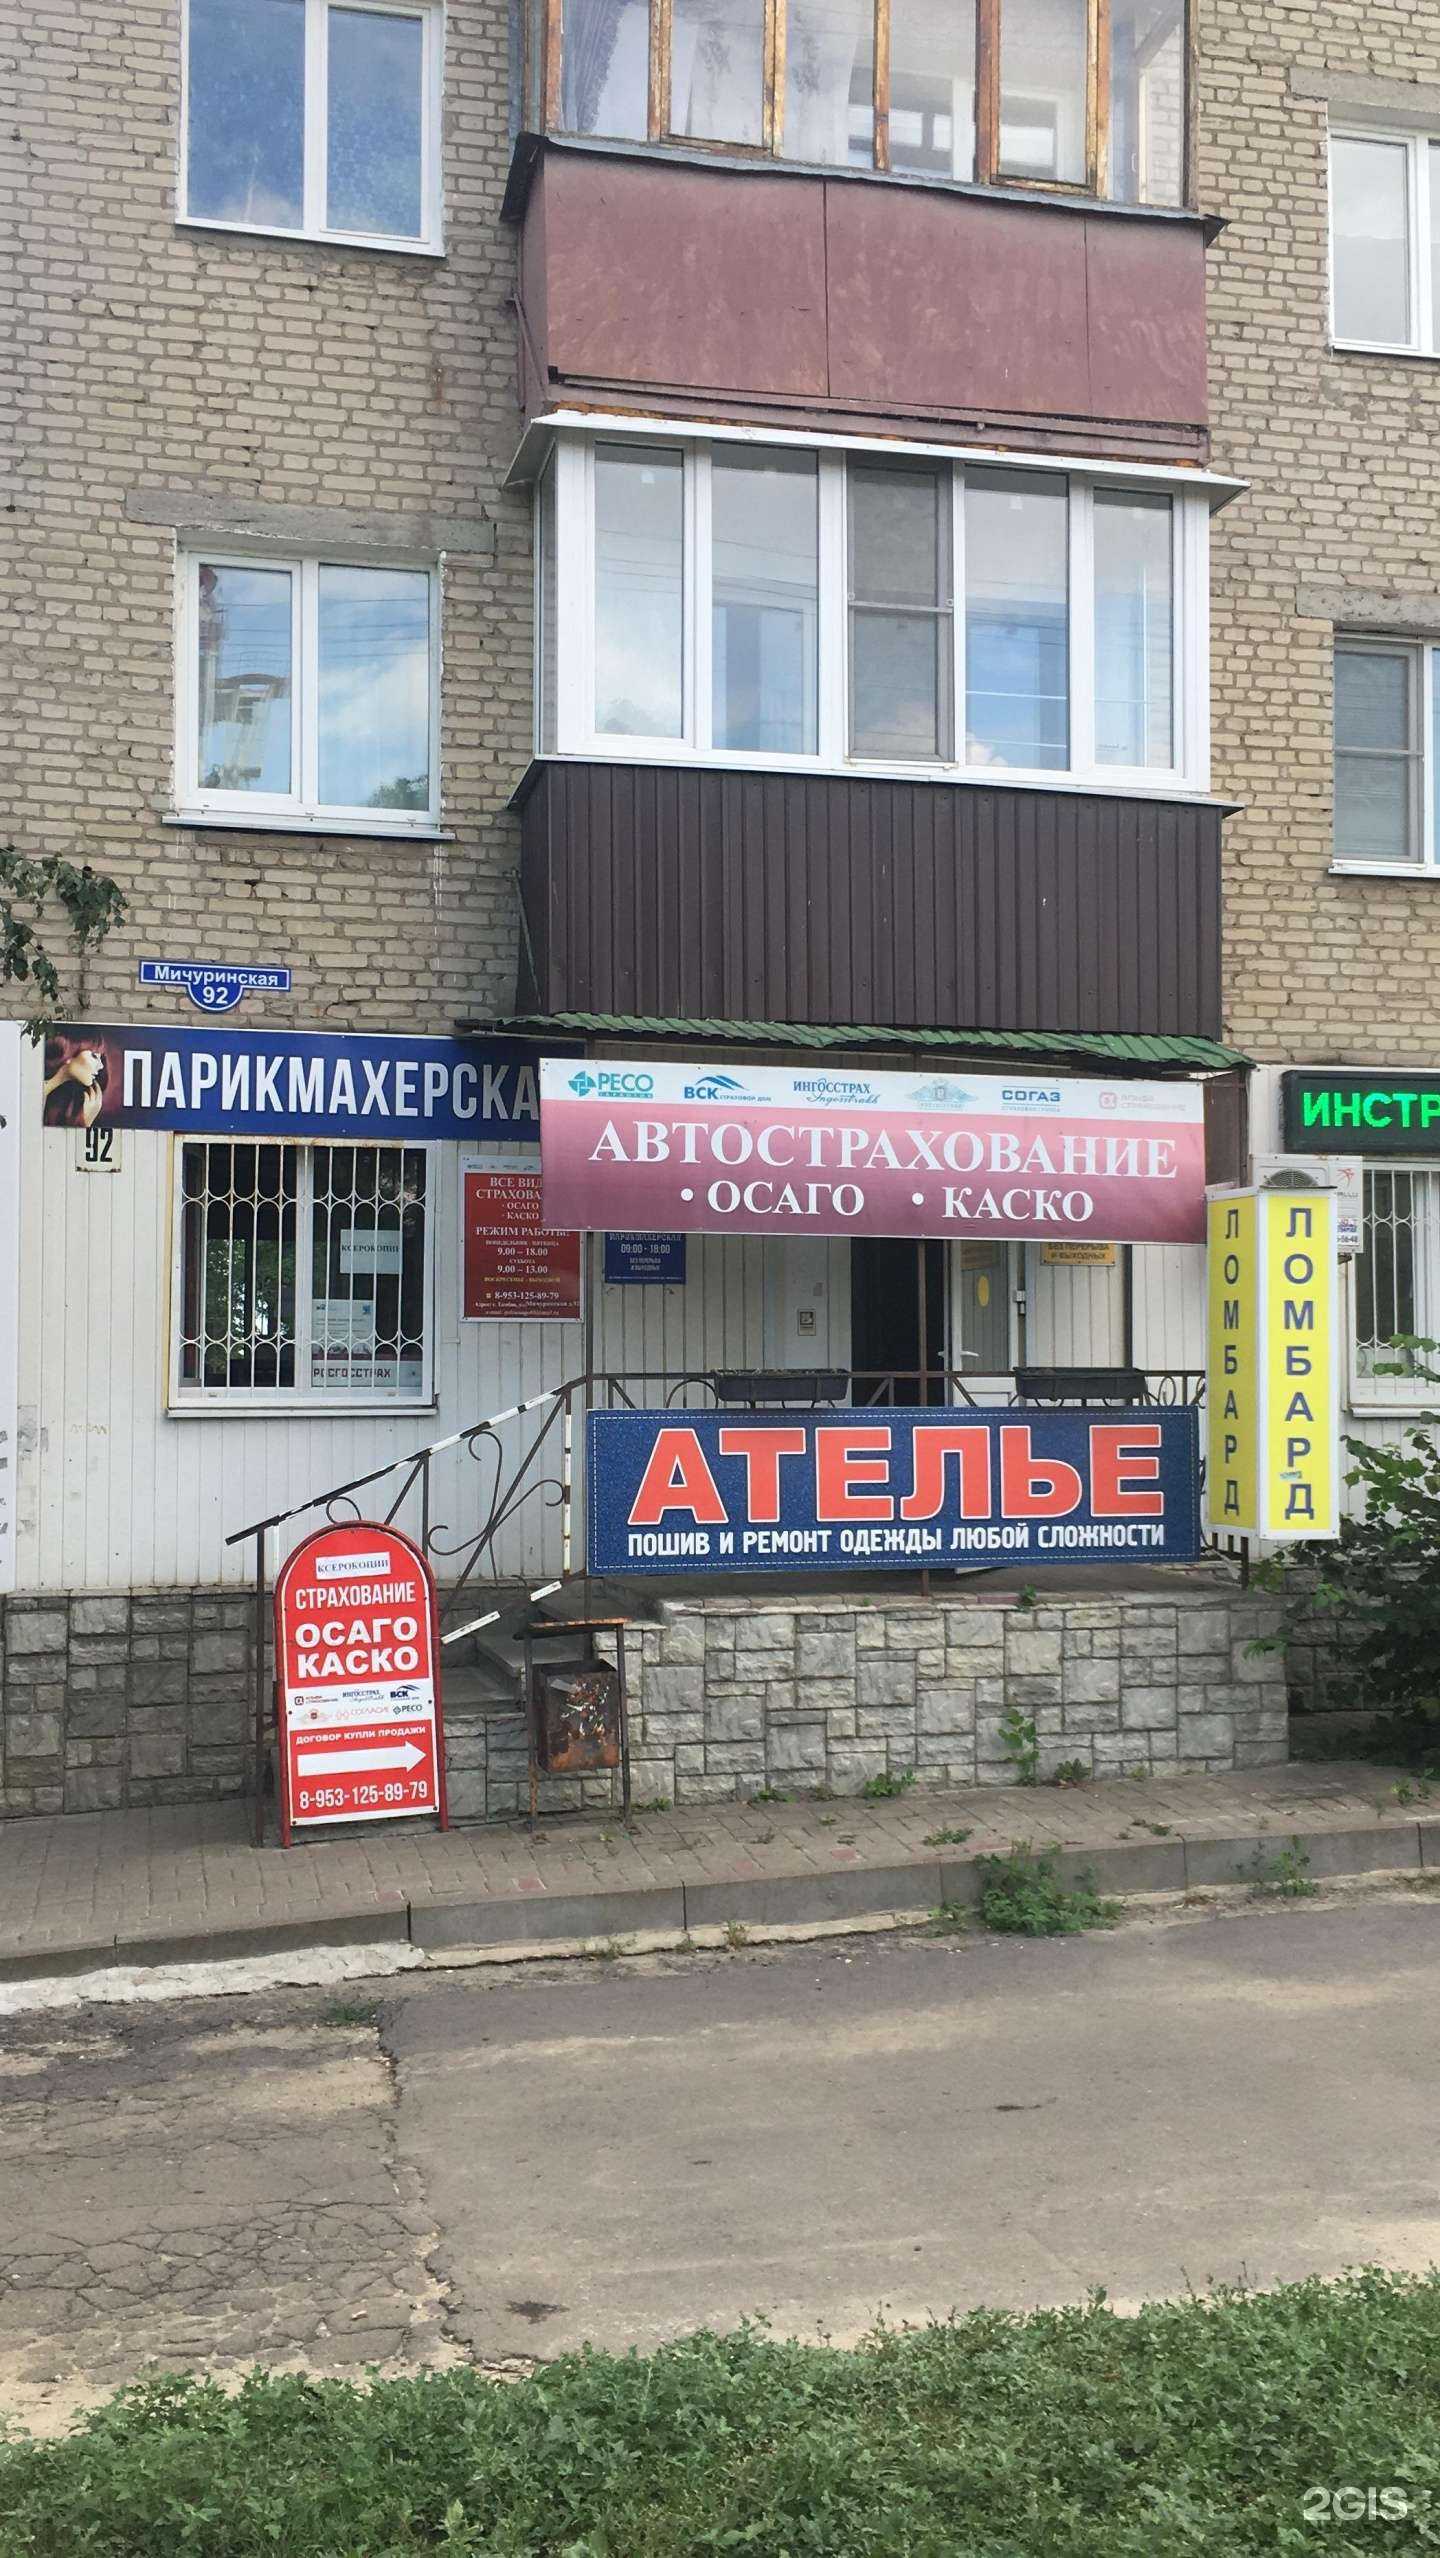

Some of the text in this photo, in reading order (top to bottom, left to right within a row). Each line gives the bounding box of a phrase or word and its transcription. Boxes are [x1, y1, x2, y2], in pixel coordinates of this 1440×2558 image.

[154, 965, 278, 986] Мичуринская
[202, 986, 229, 1005] 92
[123, 1049, 540, 1121] ПАРИКМАХЕРСКА
[597, 1072, 654, 1093] РЕСО
[793, 1080, 871, 1094] ИНГОССТРАХ
[683, 1086, 719, 1100] ВСК
[1001, 1089, 1061, 1103] СОГАЗ
[85, 1127, 113, 1162] 92
[587, 1118, 1178, 1180] АВТОСТРАХОВАНИЕ
[490, 1177, 543, 1190] ВСЕ ВИД
[476, 1189, 543, 1200] СТРАХОВА
[706, 1180, 1095, 1222] ОСАГО КАСКО
[506, 1201, 539, 1210] ОСАГО
[507, 1212, 539, 1220] КАСКО
[476, 1226, 518, 1237] РЕЖИМ
[497, 1247, 516, 1256] 9.00
[526, 1247, 549, 1256] 18.00
[497, 1265, 516, 1274] 9.00
[1223, 1208, 1240, 1517] ЛОМБАРД
[1283, 1207, 1315, 1521] ЛОМБАРД
[627, 1423, 1165, 1526] АТЕЛЬЕ
[627, 1523, 1165, 1557] ПОШИВ И РЕМОНТ ОДЕЖДЫ ЛЮБОЙ СЛОЖНОСТИ
[295, 1581, 417, 1610] СТРАХОВАНИЕ
[294, 1616, 418, 1649] ОСАГО
[297, 1645, 419, 1679] КАСКО
[390, 1690, 409, 1699] ВСК
[401, 1704, 423, 1713] РЕСО
[295, 1726, 426, 1745] ДОГОВОР КУПЛИ ПРОДАЖИ
[299, 1780, 428, 1810] 8-953-125-89-79
